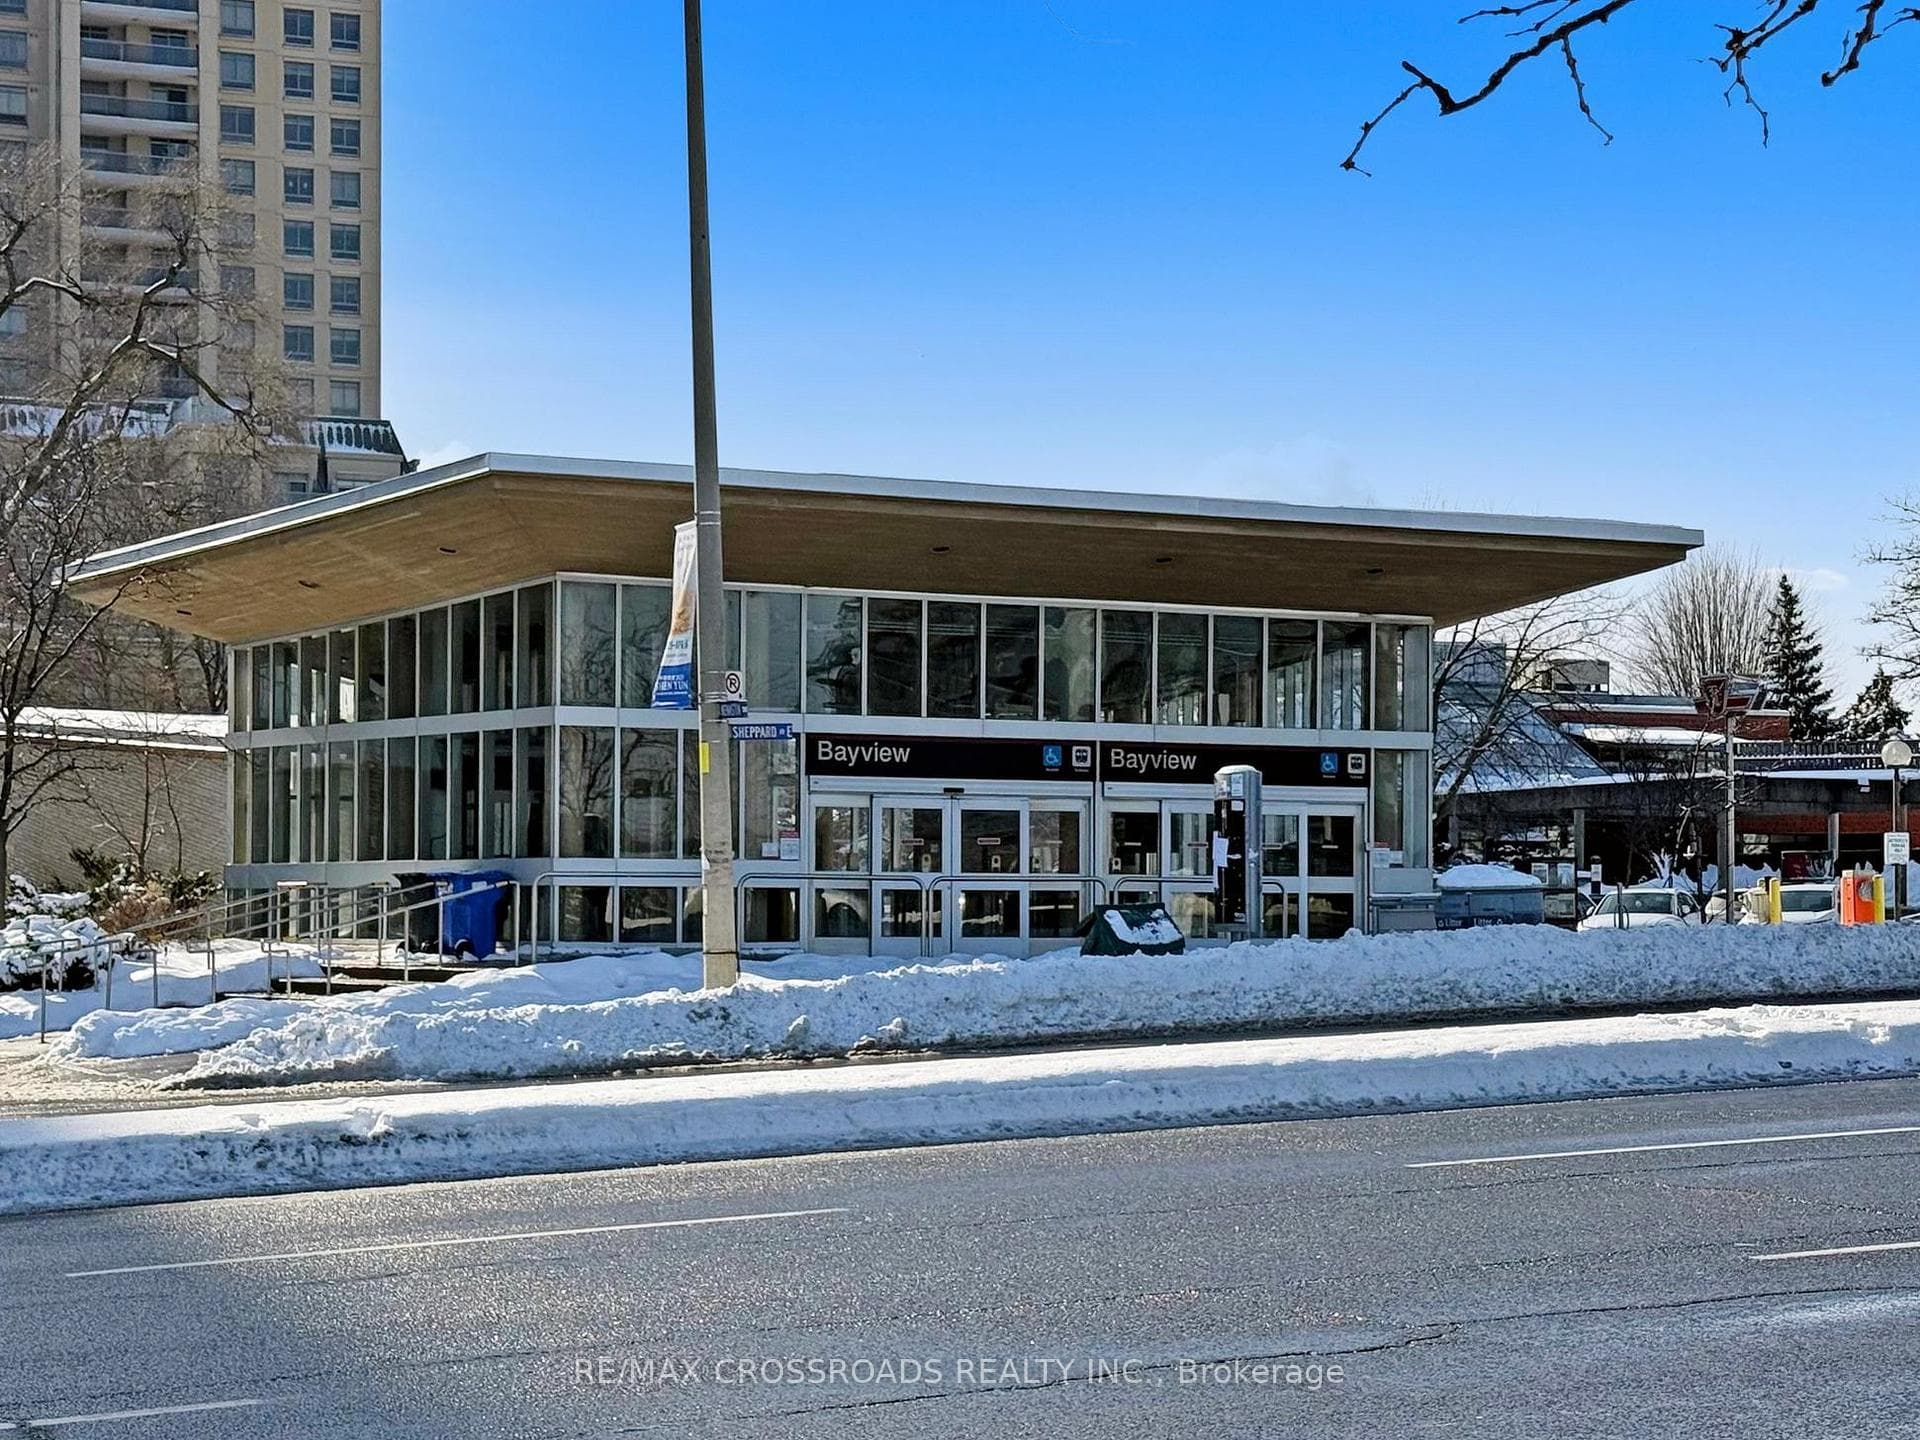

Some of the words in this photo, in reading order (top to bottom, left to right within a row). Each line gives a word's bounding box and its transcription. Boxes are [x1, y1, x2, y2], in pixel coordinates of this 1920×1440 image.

[732, 726, 777, 738] SHEPPARD
[786, 726, 792, 738] E
[817, 740, 910, 766] Bayview
[1111, 748, 1197, 773] Bayview
